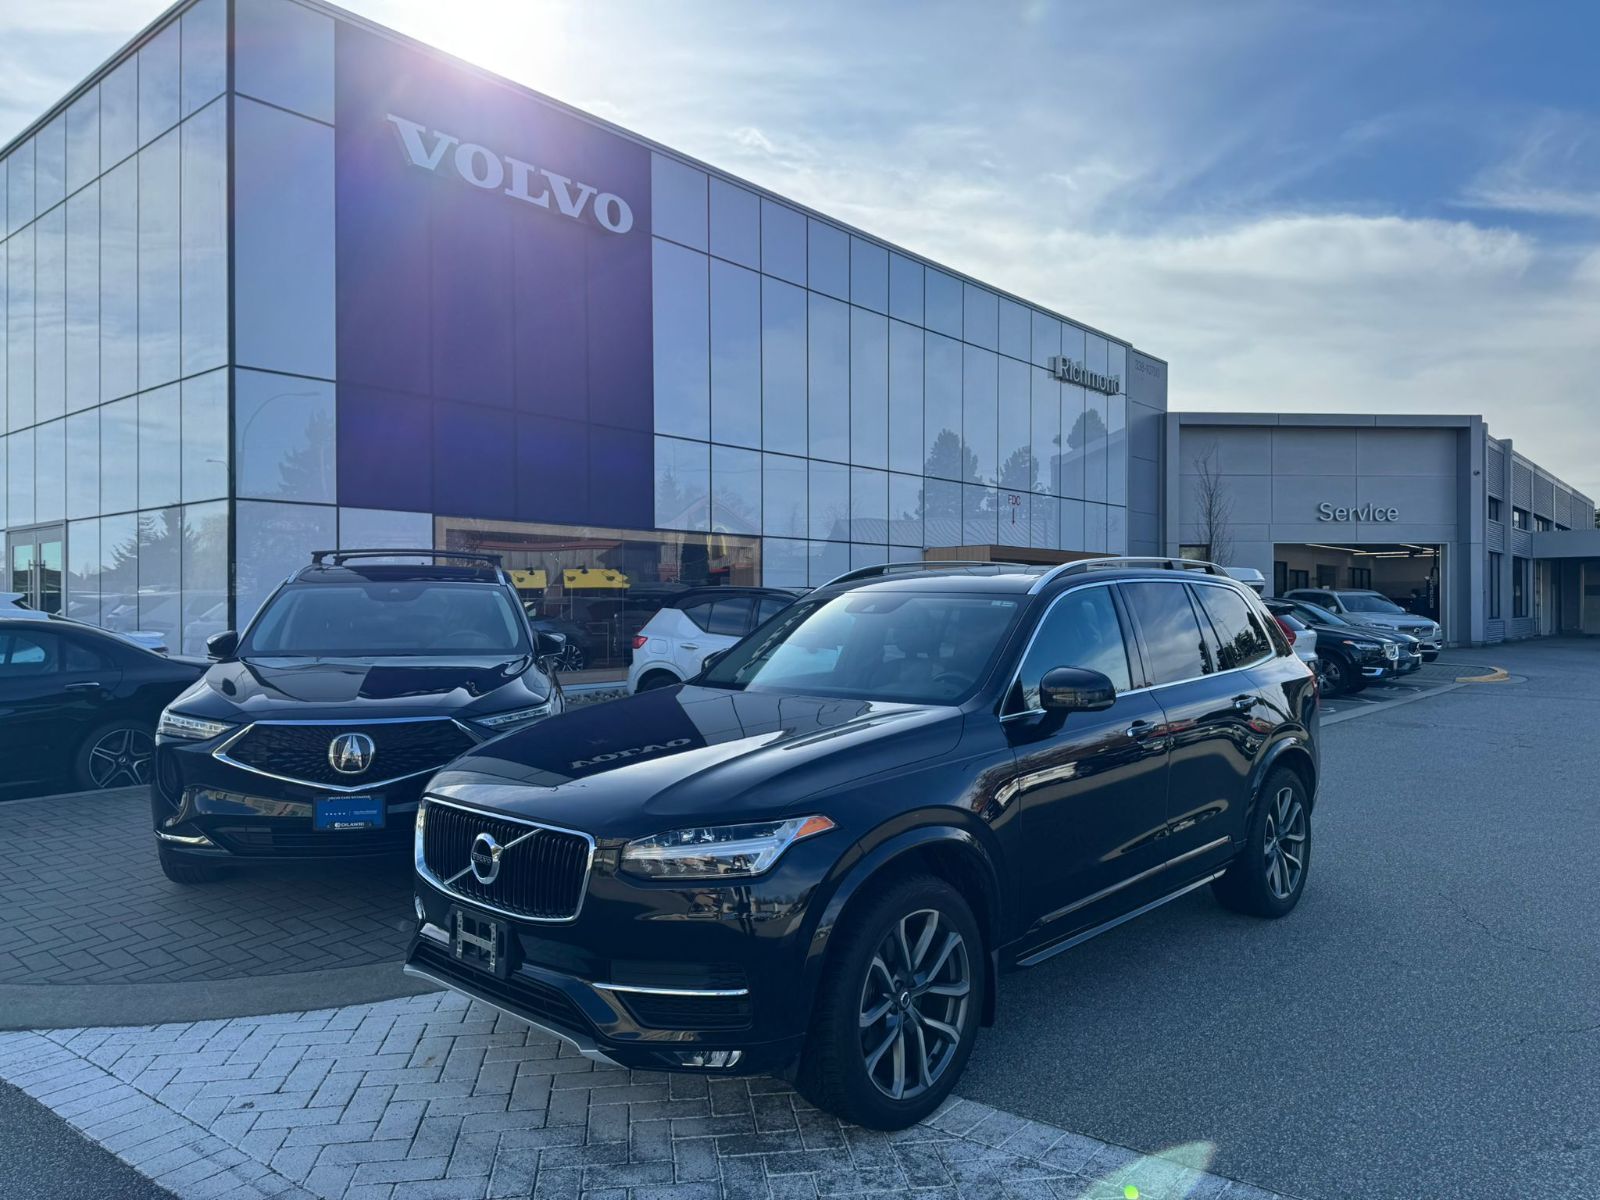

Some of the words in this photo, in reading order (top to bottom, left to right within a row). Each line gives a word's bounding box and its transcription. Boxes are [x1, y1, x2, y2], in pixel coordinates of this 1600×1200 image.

[386, 113, 634, 234] VOLVO
[1055, 356, 1120, 394] Richmond
[1319, 501, 1400, 522] Service
